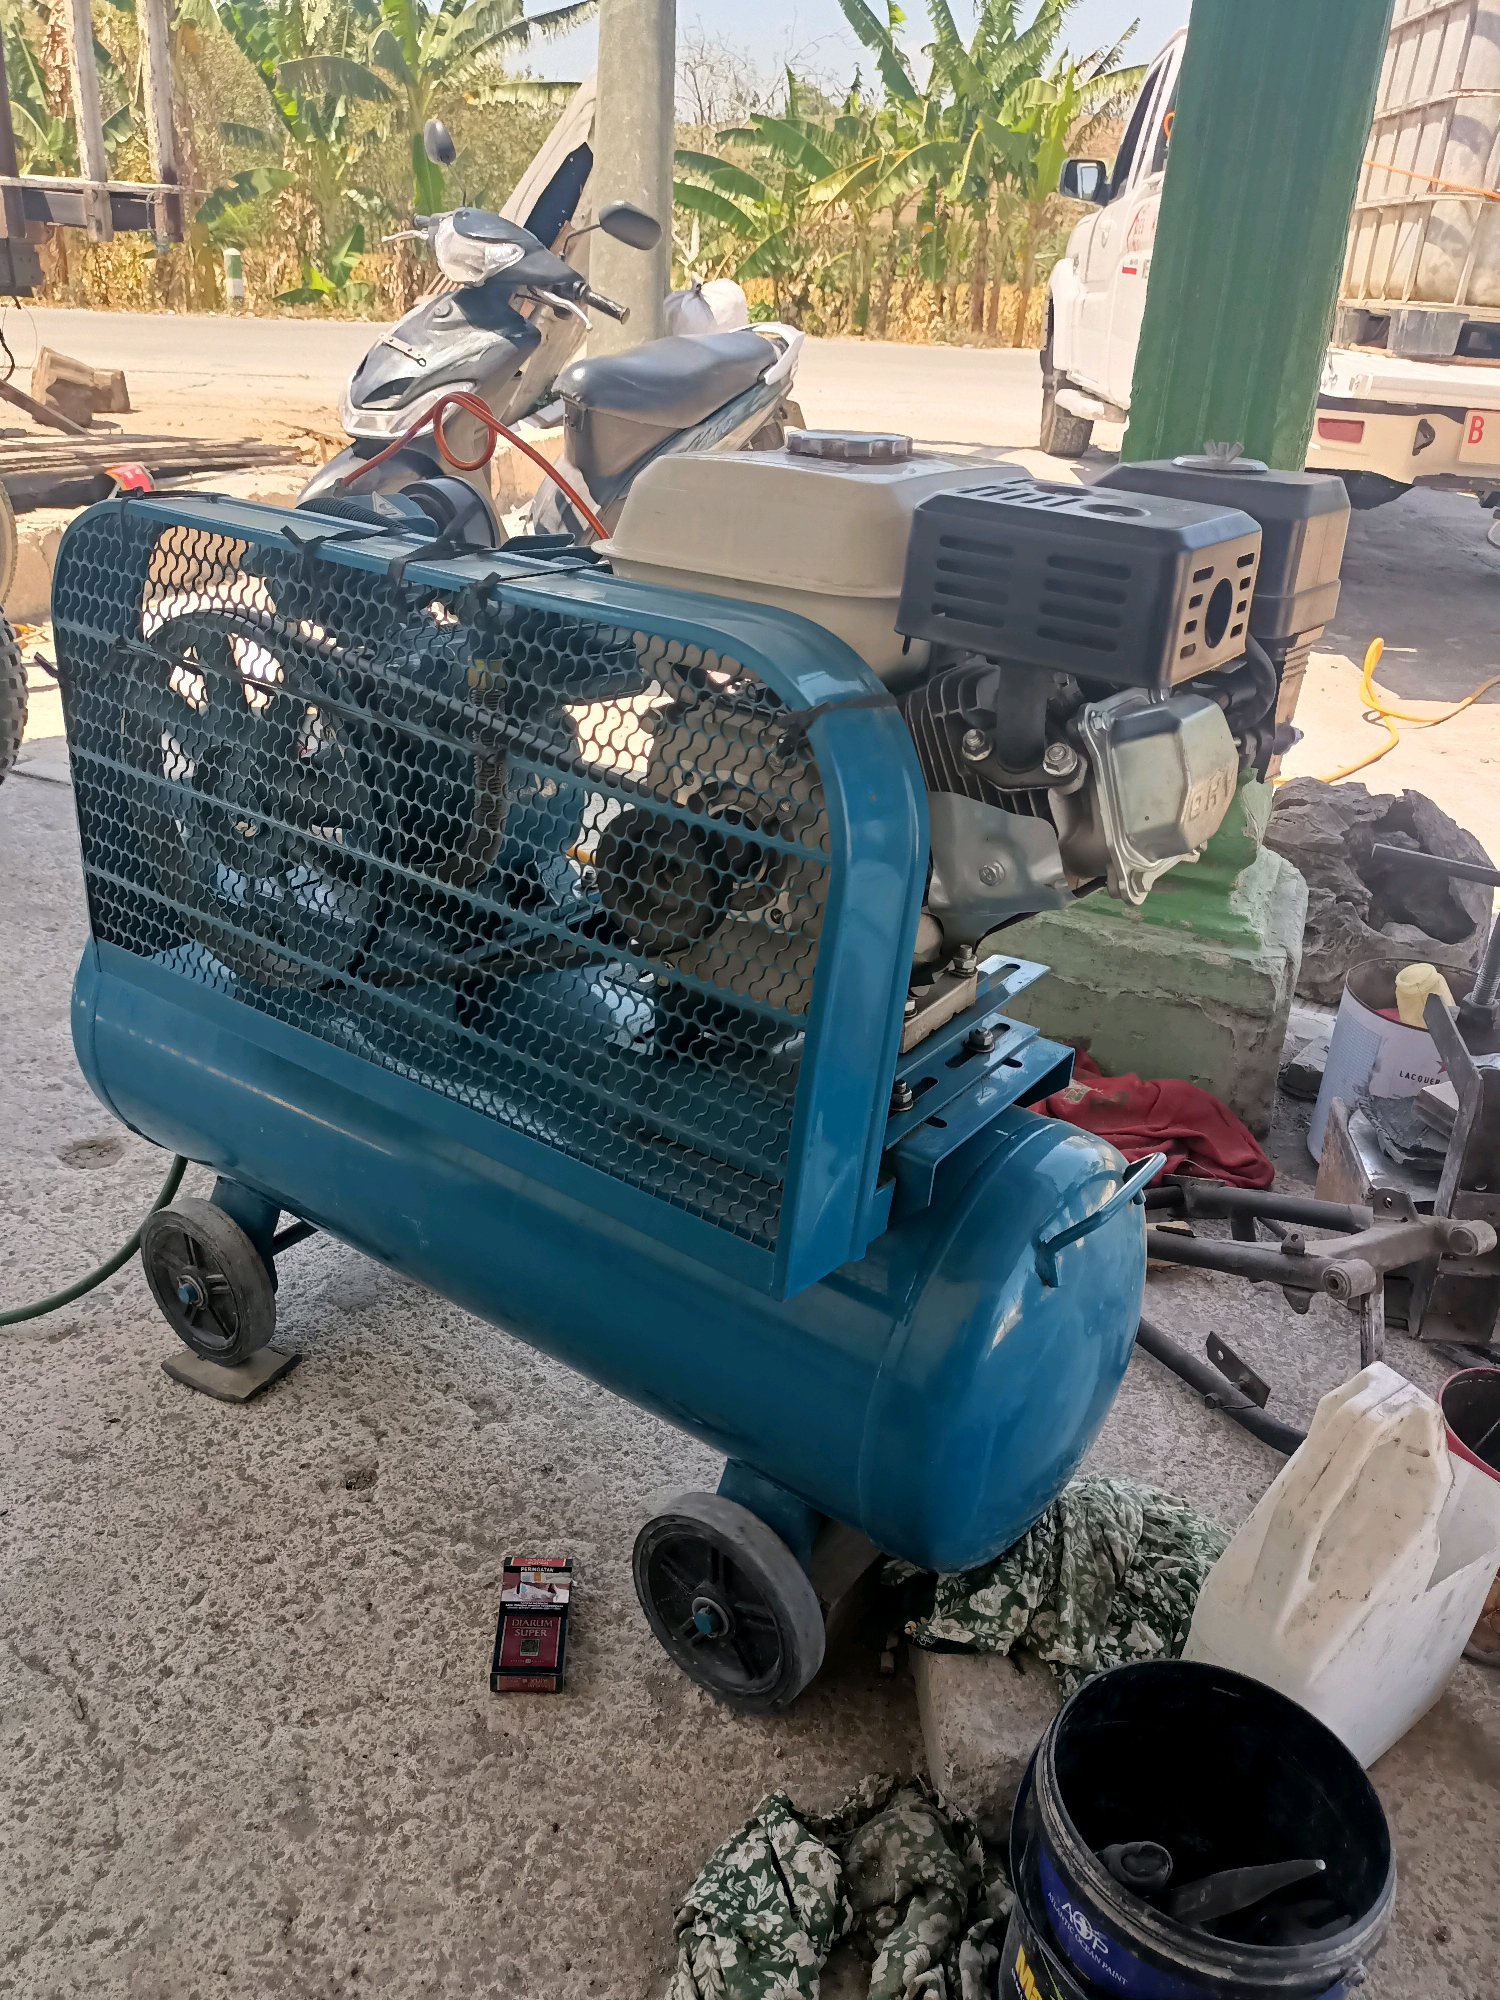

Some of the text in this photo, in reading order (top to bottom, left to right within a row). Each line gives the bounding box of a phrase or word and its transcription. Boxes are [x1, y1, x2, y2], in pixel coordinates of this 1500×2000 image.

[1467, 415, 1485, 444] B
[514, 1628, 548, 1637] SUPER
[1047, 1892, 1128, 1986] ATLANTIC OCEAN PAINT
